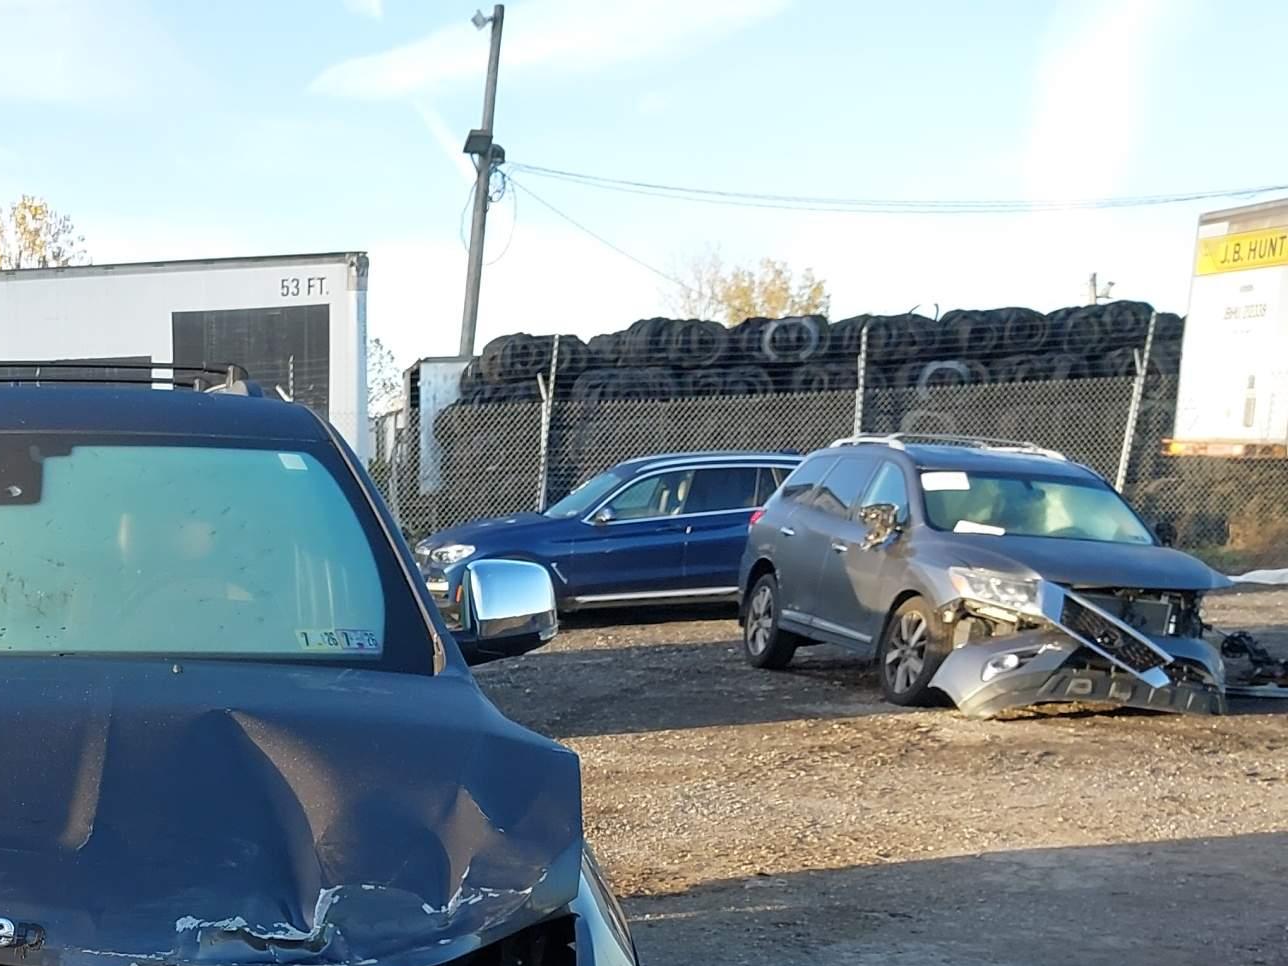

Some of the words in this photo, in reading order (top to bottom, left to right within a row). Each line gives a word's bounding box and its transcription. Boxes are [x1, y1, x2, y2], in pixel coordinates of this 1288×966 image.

[1220, 242, 1243, 264] J.B.
[1247, 235, 1287, 260] HUNT
[280, 278, 300, 297] 53
[307, 276, 330, 296] FT.
